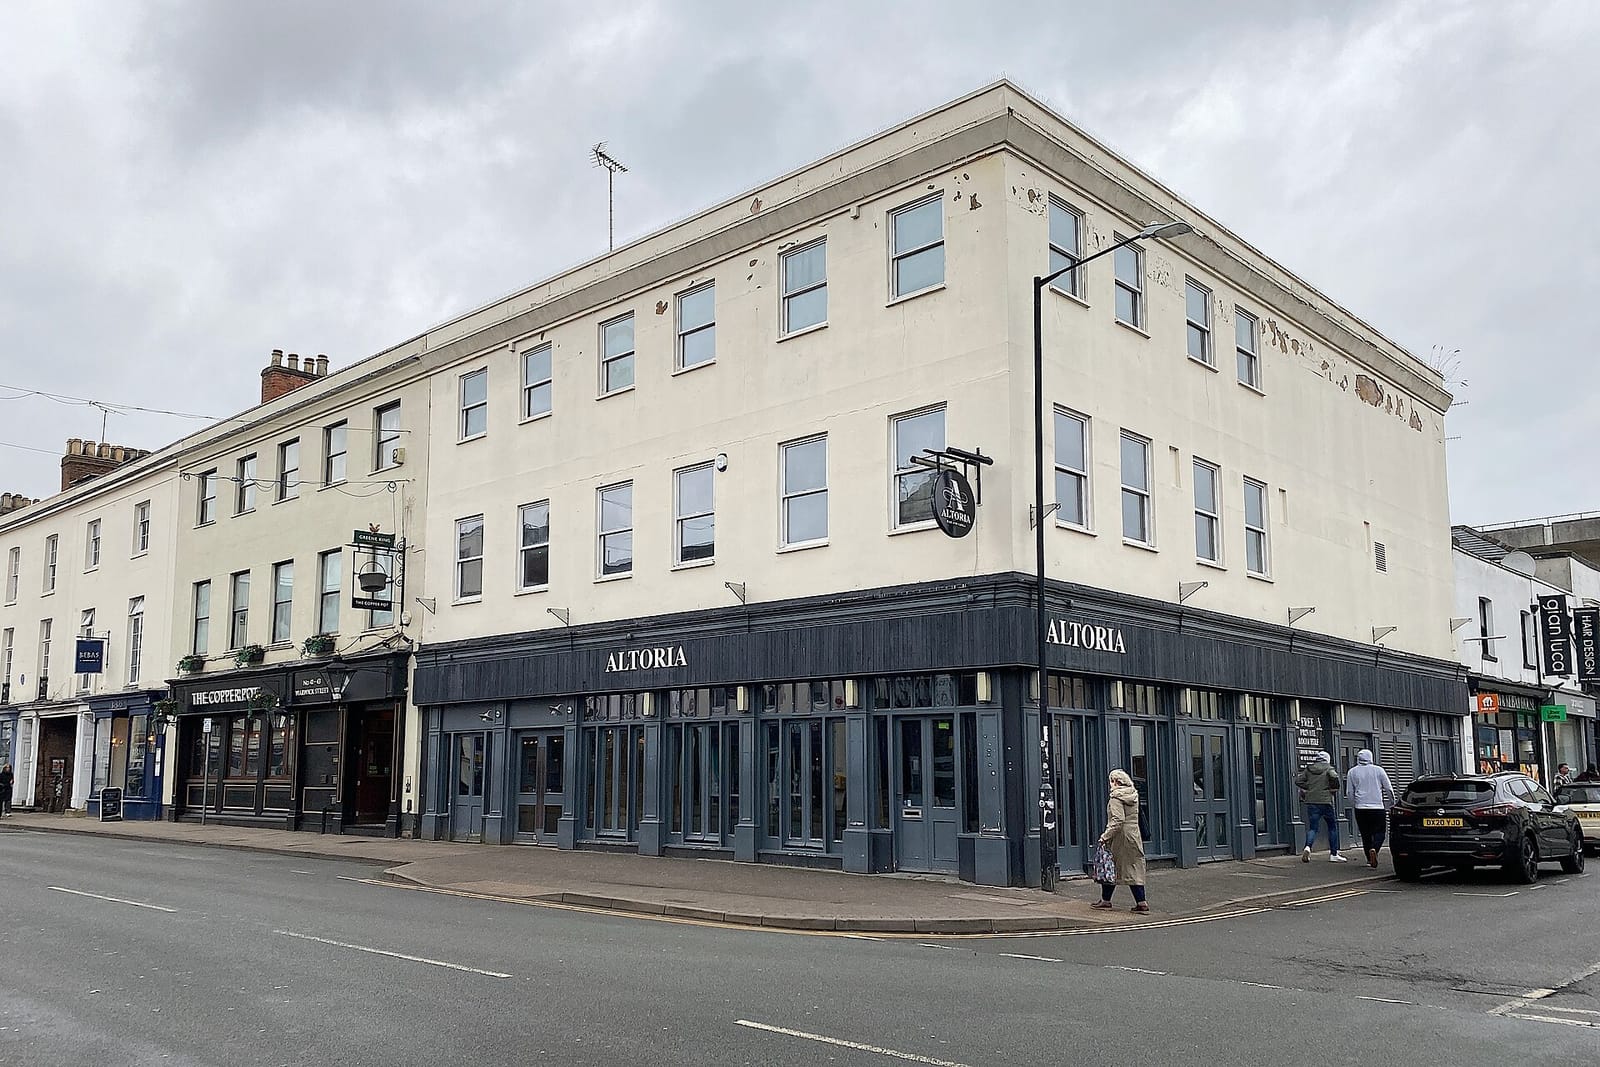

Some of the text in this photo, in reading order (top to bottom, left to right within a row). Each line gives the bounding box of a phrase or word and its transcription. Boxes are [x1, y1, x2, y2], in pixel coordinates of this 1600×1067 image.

[941, 508, 972, 524] ALTORIA
[1045, 618, 1126, 654] ALTORIA
[1542, 599, 1568, 672] gian luca
[1581, 615, 1596, 675] HAIR DESIGN
[79, 651, 100, 659] BEBAS
[605, 645, 688, 673] ALTORIA
[191, 686, 261, 705] THE COPPER POT
[1300, 716, 1315, 728] FREE
